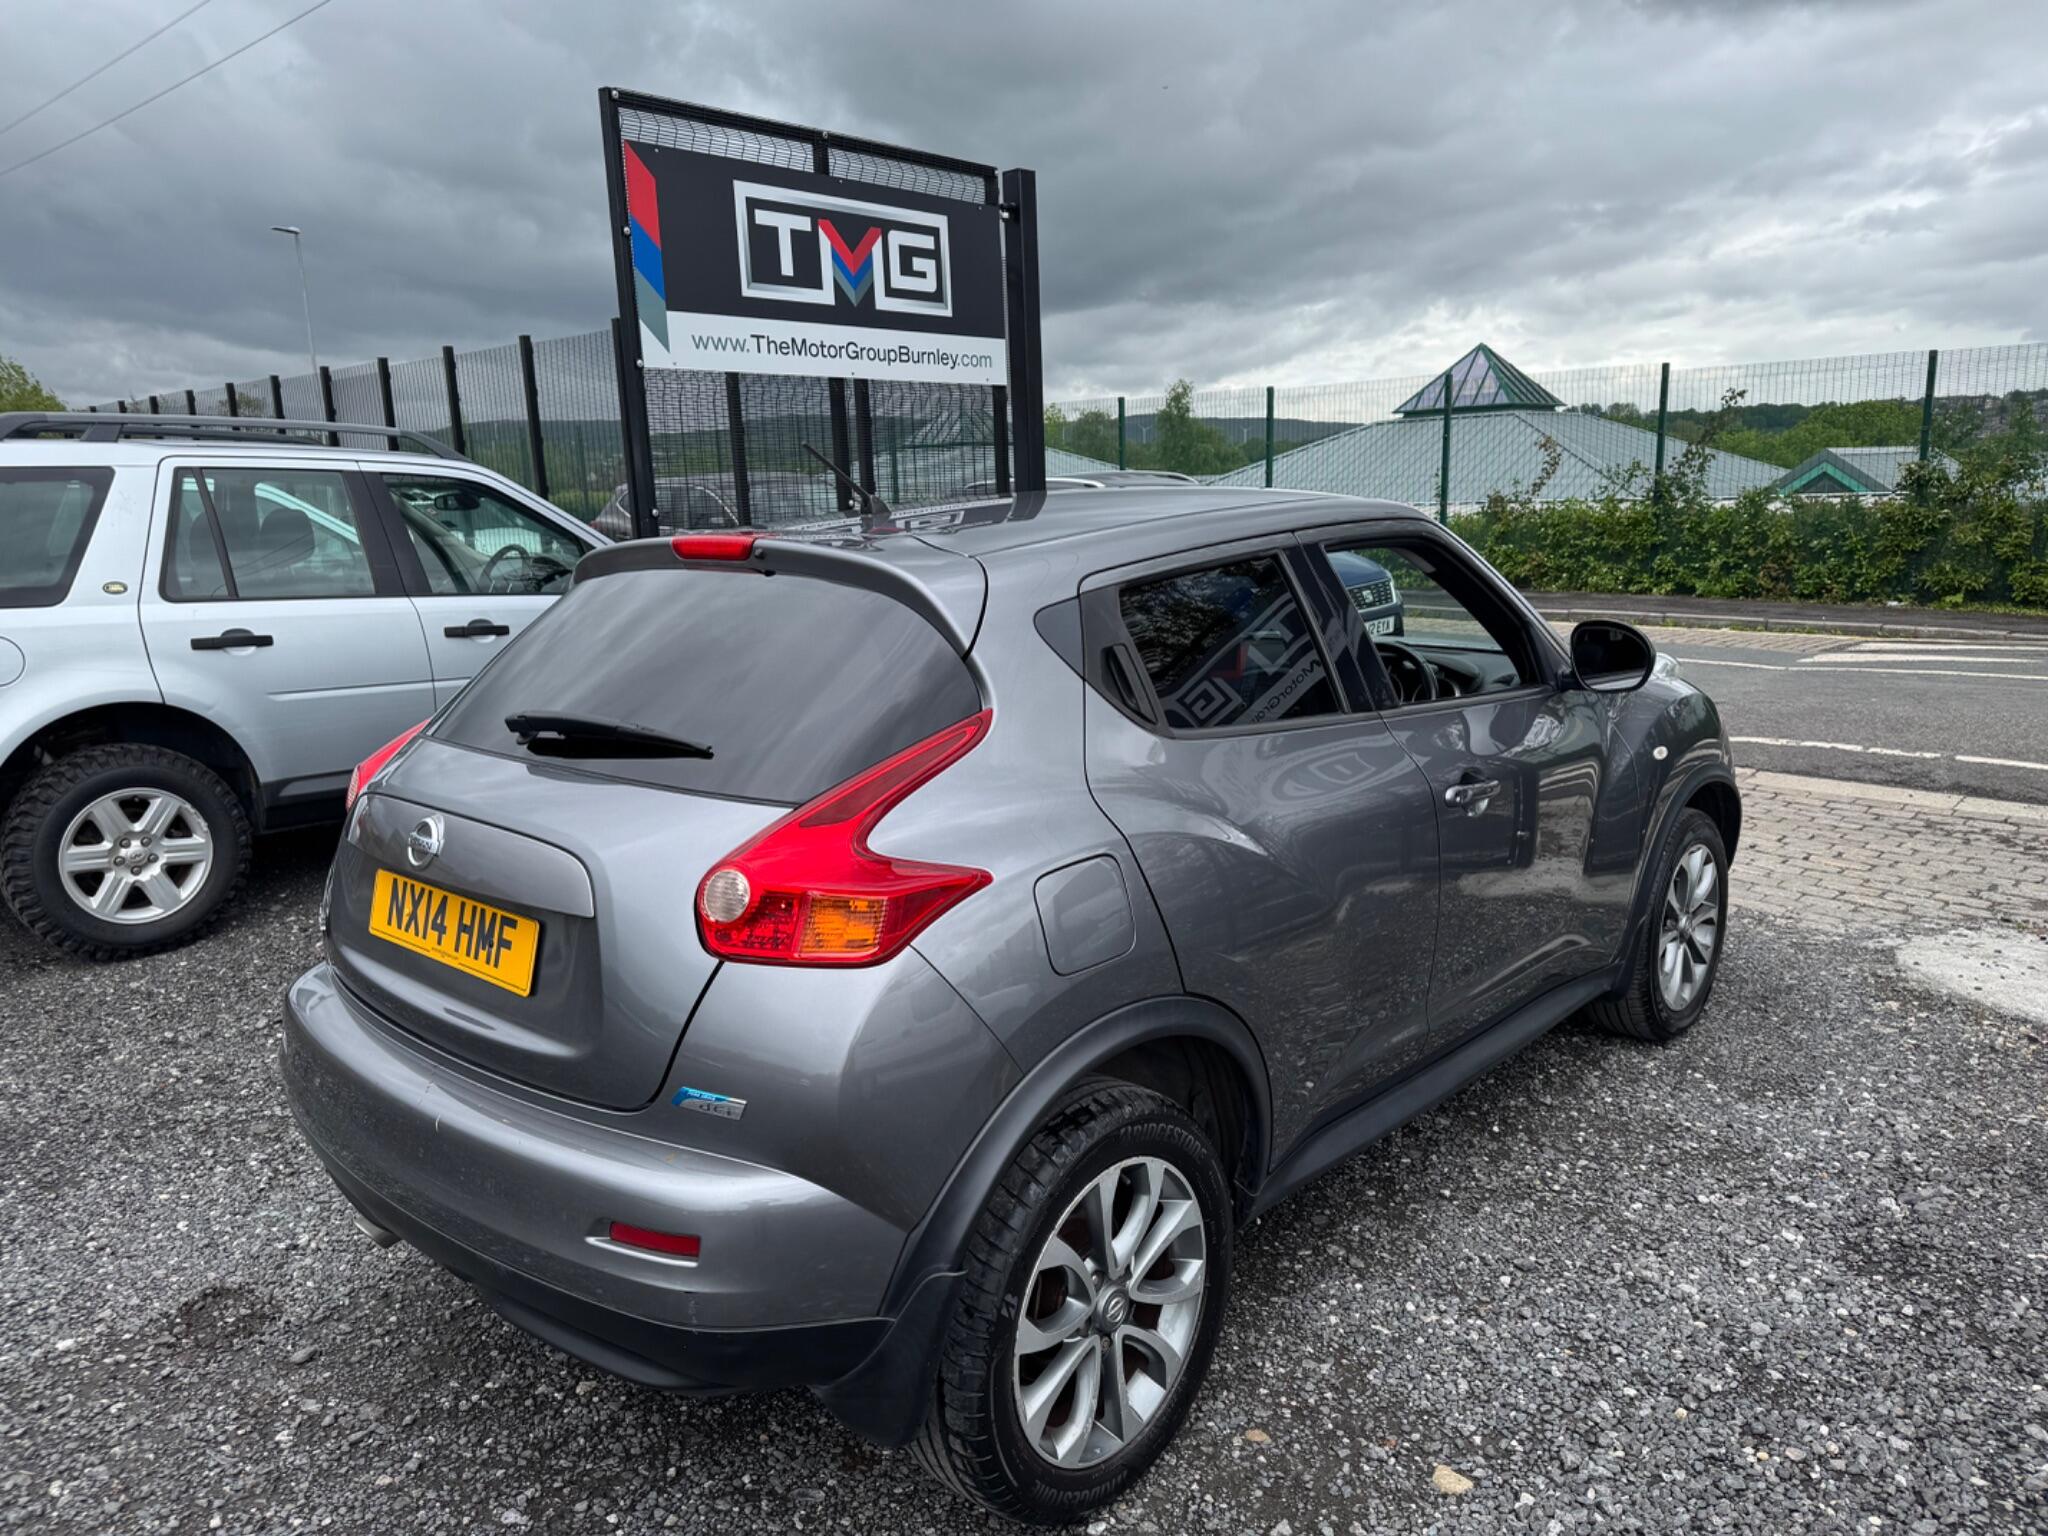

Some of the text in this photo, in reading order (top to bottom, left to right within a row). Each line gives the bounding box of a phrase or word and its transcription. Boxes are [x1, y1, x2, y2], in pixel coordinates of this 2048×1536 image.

[754, 208, 937, 307] TMG
[691, 334, 993, 369] www.TheMotorGroupBurnley.com
[387, 878, 518, 969] NX14 HMF
